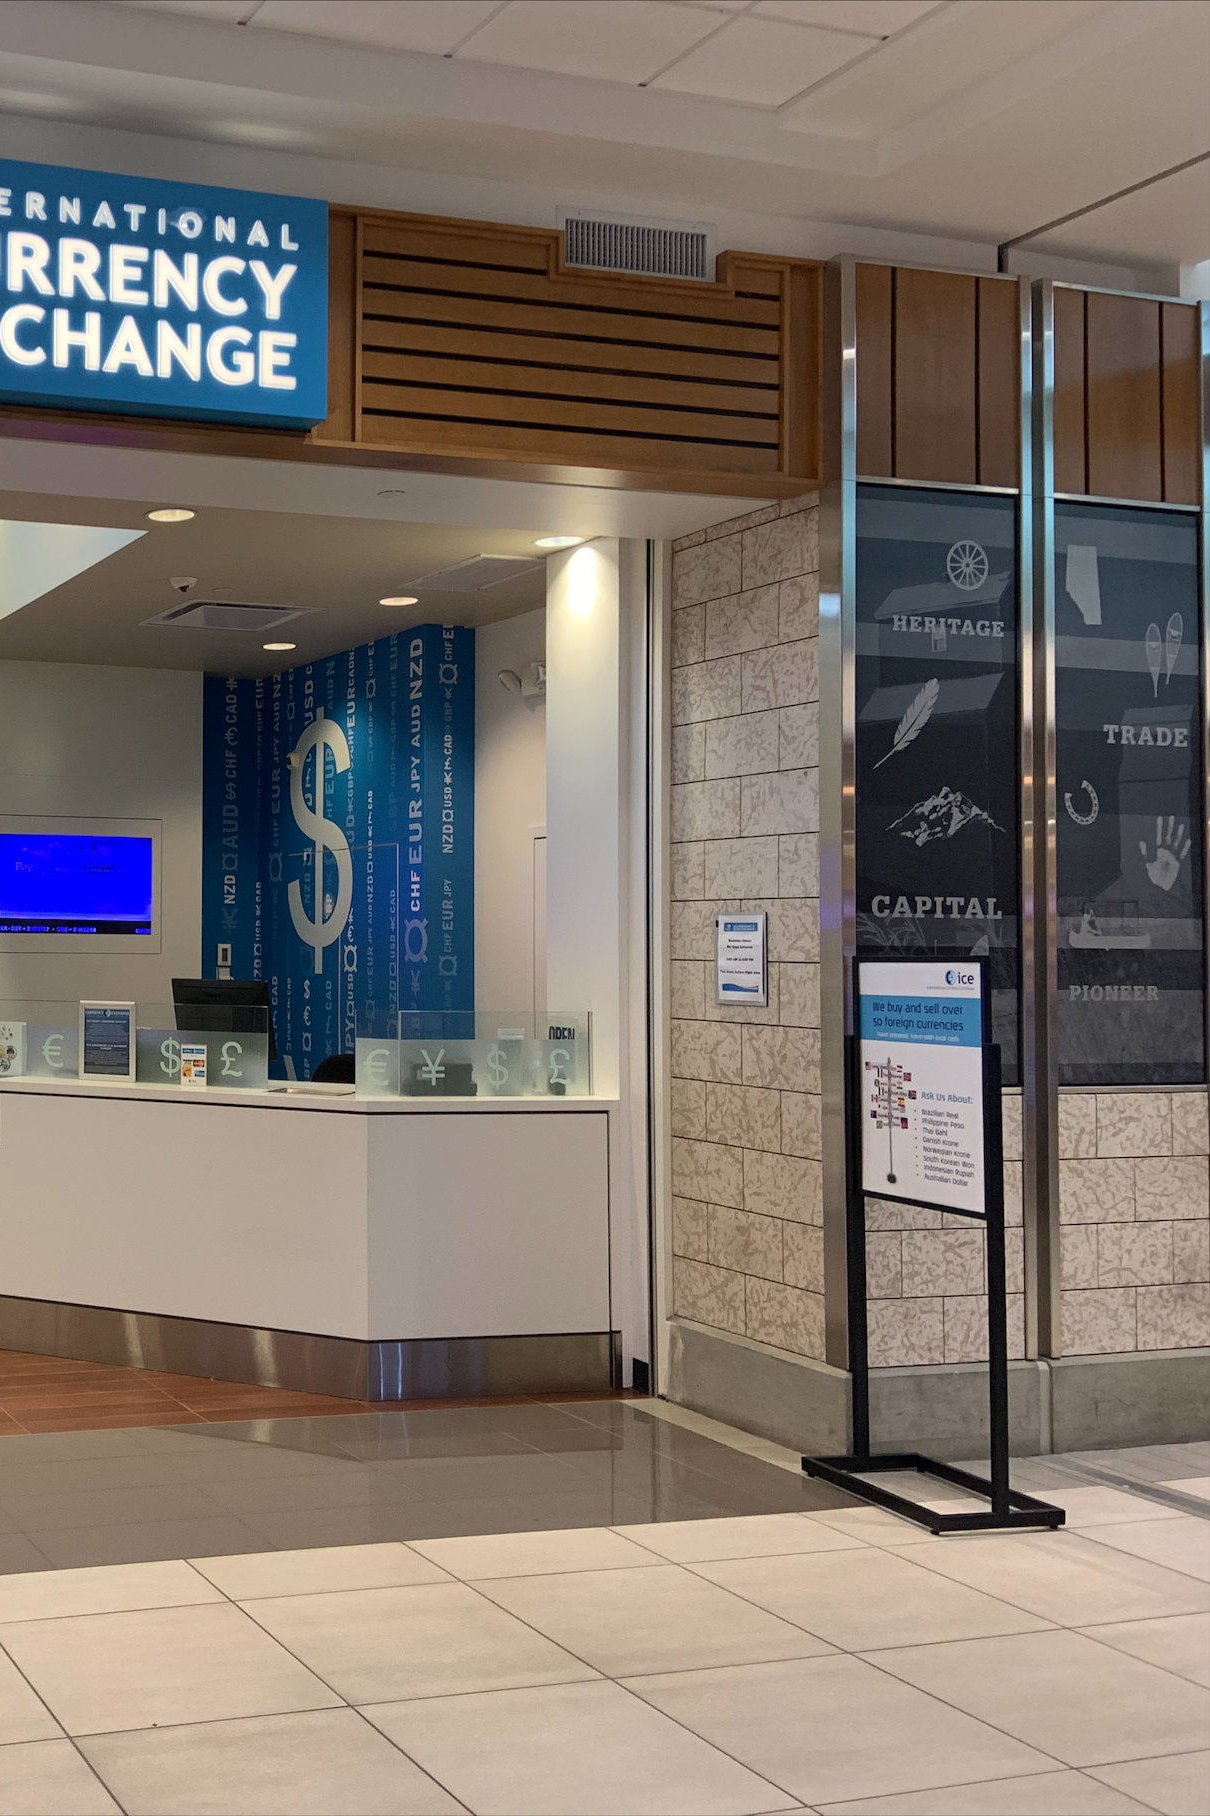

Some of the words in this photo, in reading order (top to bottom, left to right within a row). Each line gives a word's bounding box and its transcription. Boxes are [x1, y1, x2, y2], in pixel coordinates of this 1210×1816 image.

[891, 614, 1005, 638] HERITAGE
[410, 638, 423, 700] NZD
[225, 694, 237, 723] CAD
[346, 687, 356, 727] EUR
[411, 704, 421, 747] AUD
[1103, 724, 1188, 748] TRADE
[443, 735, 453, 755] CAD
[225, 750, 237, 778] CHF
[411, 755, 421, 793] JPY
[271, 768, 280, 813] EUR
[443, 787, 453, 807] USD
[222, 805, 239, 849] AUD
[409, 800, 423, 865] EUR
[442, 825, 454, 854] NZD
[223, 875, 236, 904] NZD
[410, 870, 420, 912] CHF
[442, 900, 454, 930] EUR
[871, 895, 1003, 920] CAPITAL
[957, 971, 975, 985] ice
[1068, 983, 1160, 1002] PIONEER
[873, 1002, 885, 1012] We
[887, 1002, 903, 1014] buy
[905, 1003, 921, 1014] and
[924, 1003, 940, 1014] sell
[942, 1006, 963, 1015] over
[885, 1016, 914, 1030] foreign
[916, 1019, 964, 1031] currencies
[921, 1091, 935, 1100] Ask
[936, 1093, 946, 1102] Us
[947, 1094, 974, 1104] About:
